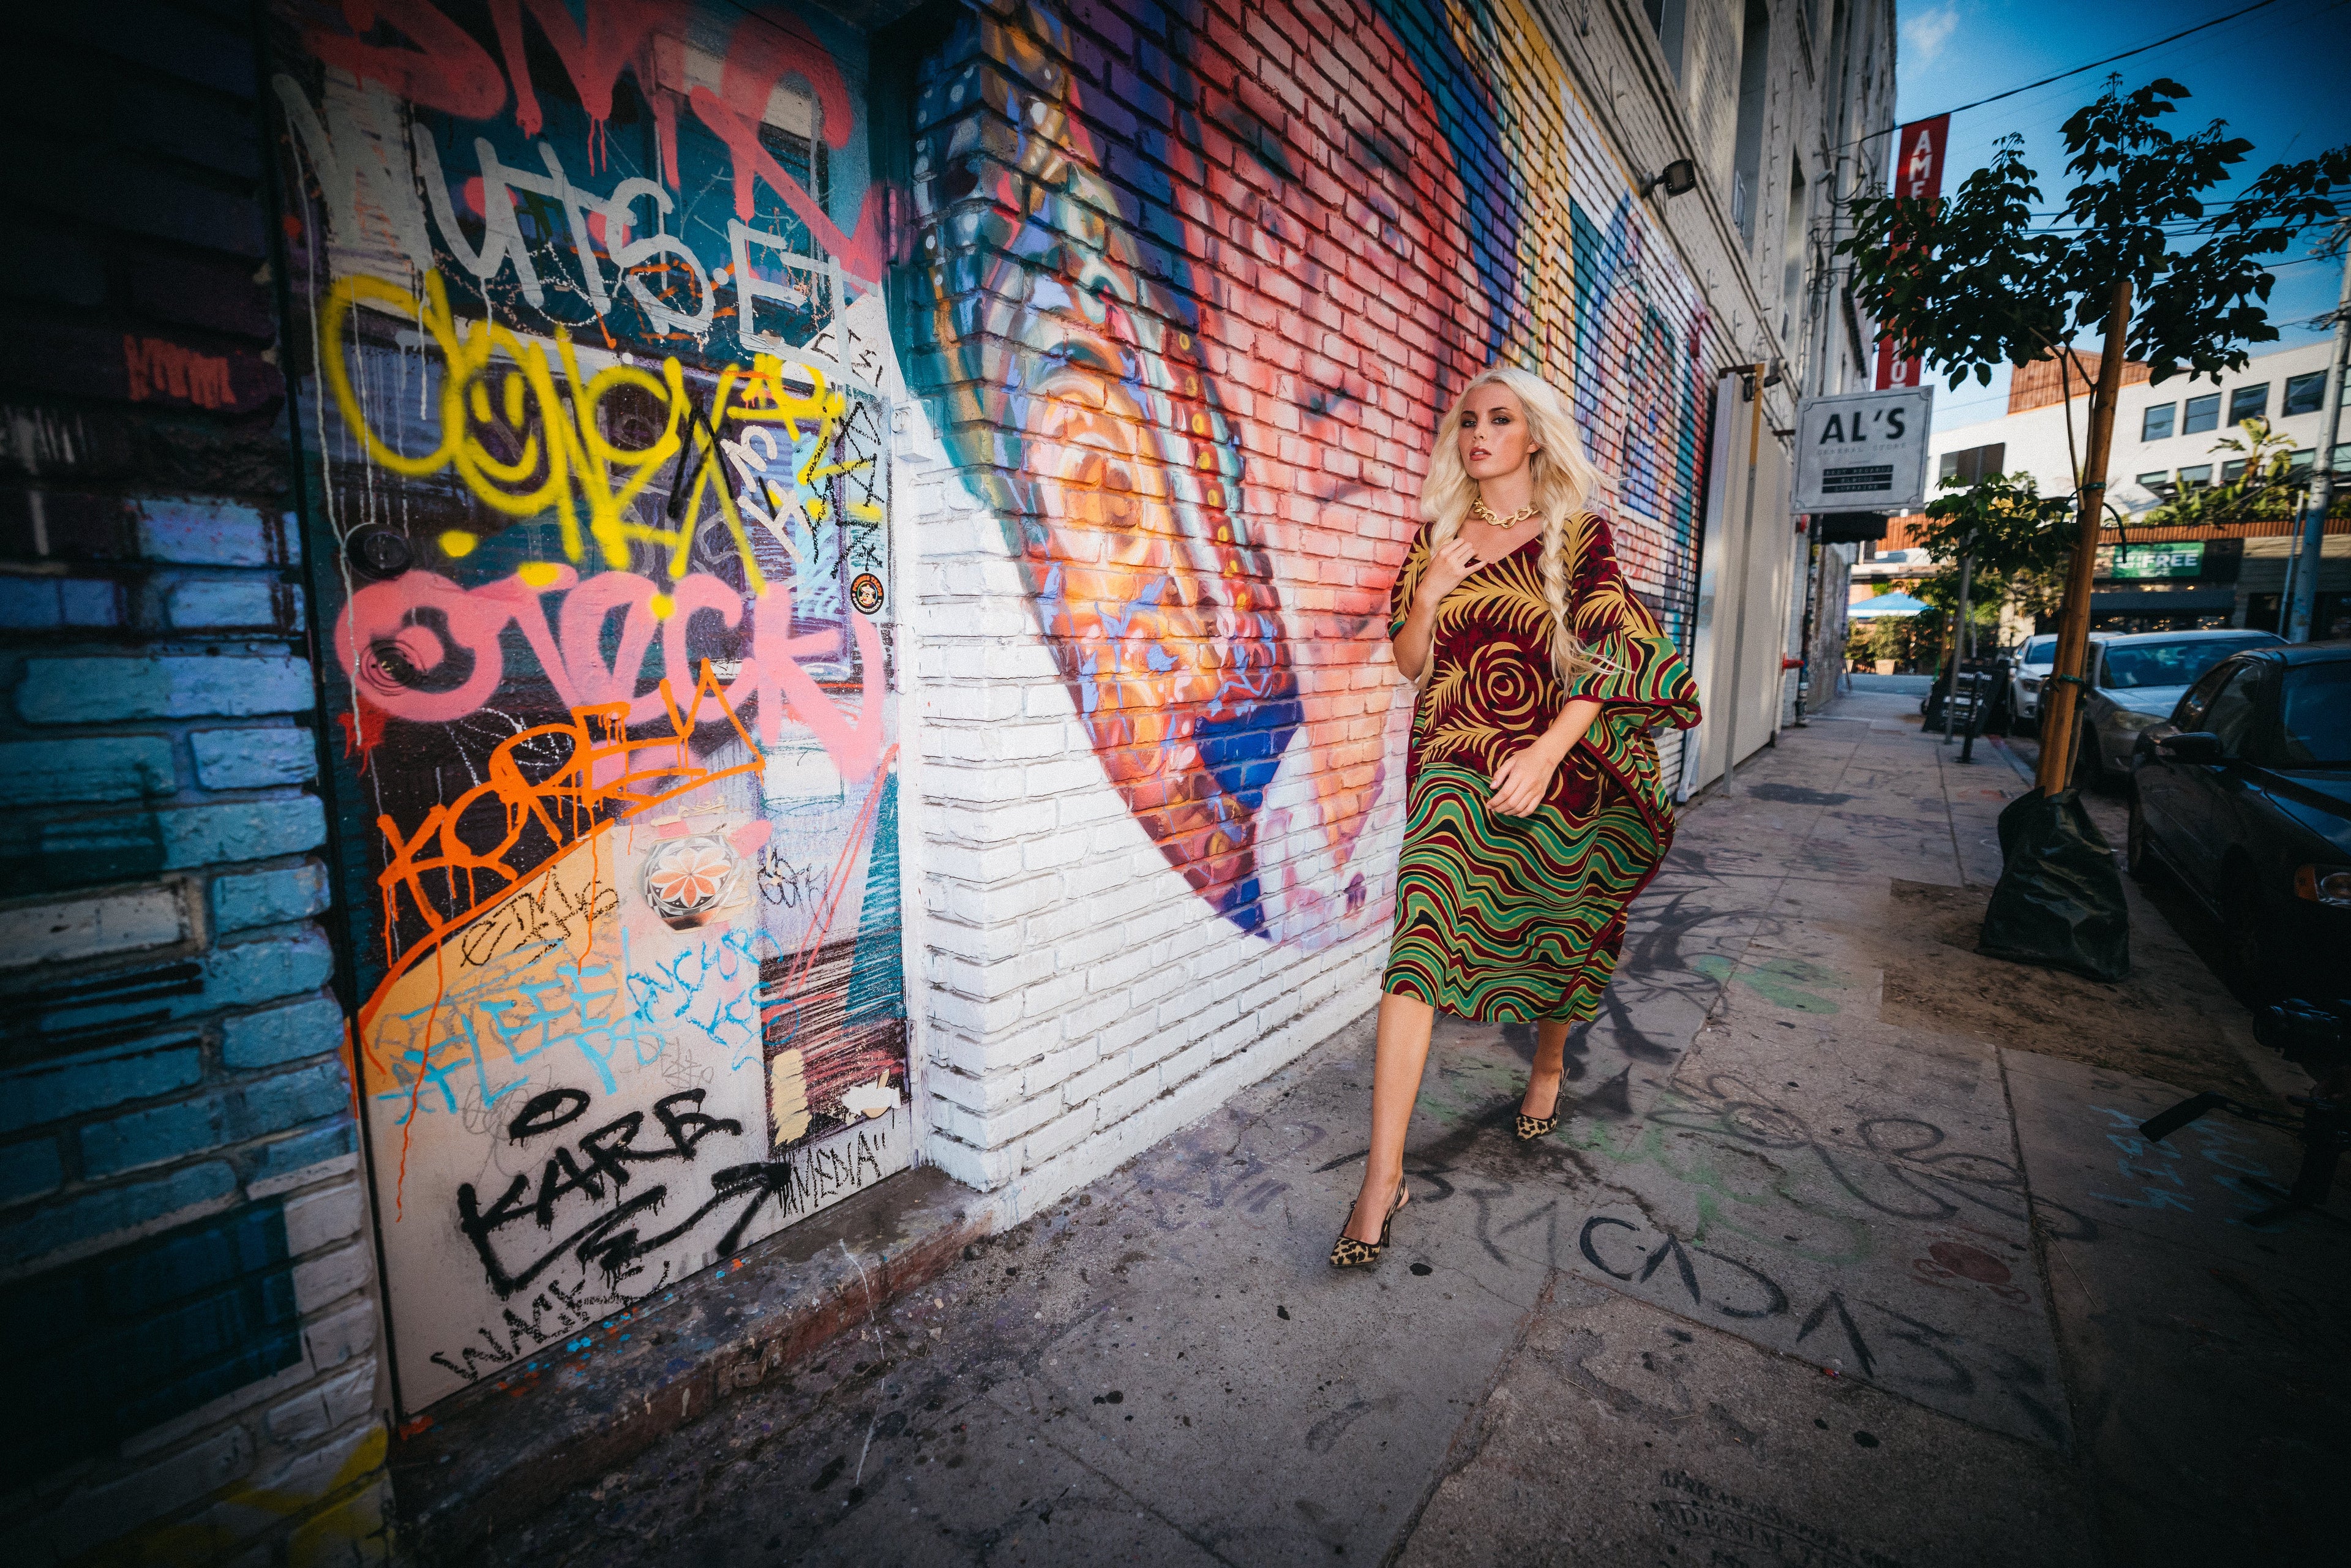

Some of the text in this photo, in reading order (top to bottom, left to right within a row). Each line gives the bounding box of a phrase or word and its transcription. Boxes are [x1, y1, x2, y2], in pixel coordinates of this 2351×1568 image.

[1819, 407, 1906, 445] AL'S
[2142, 553, 2200, 568] FREE
[871, 576, 883, 597] TACOS
